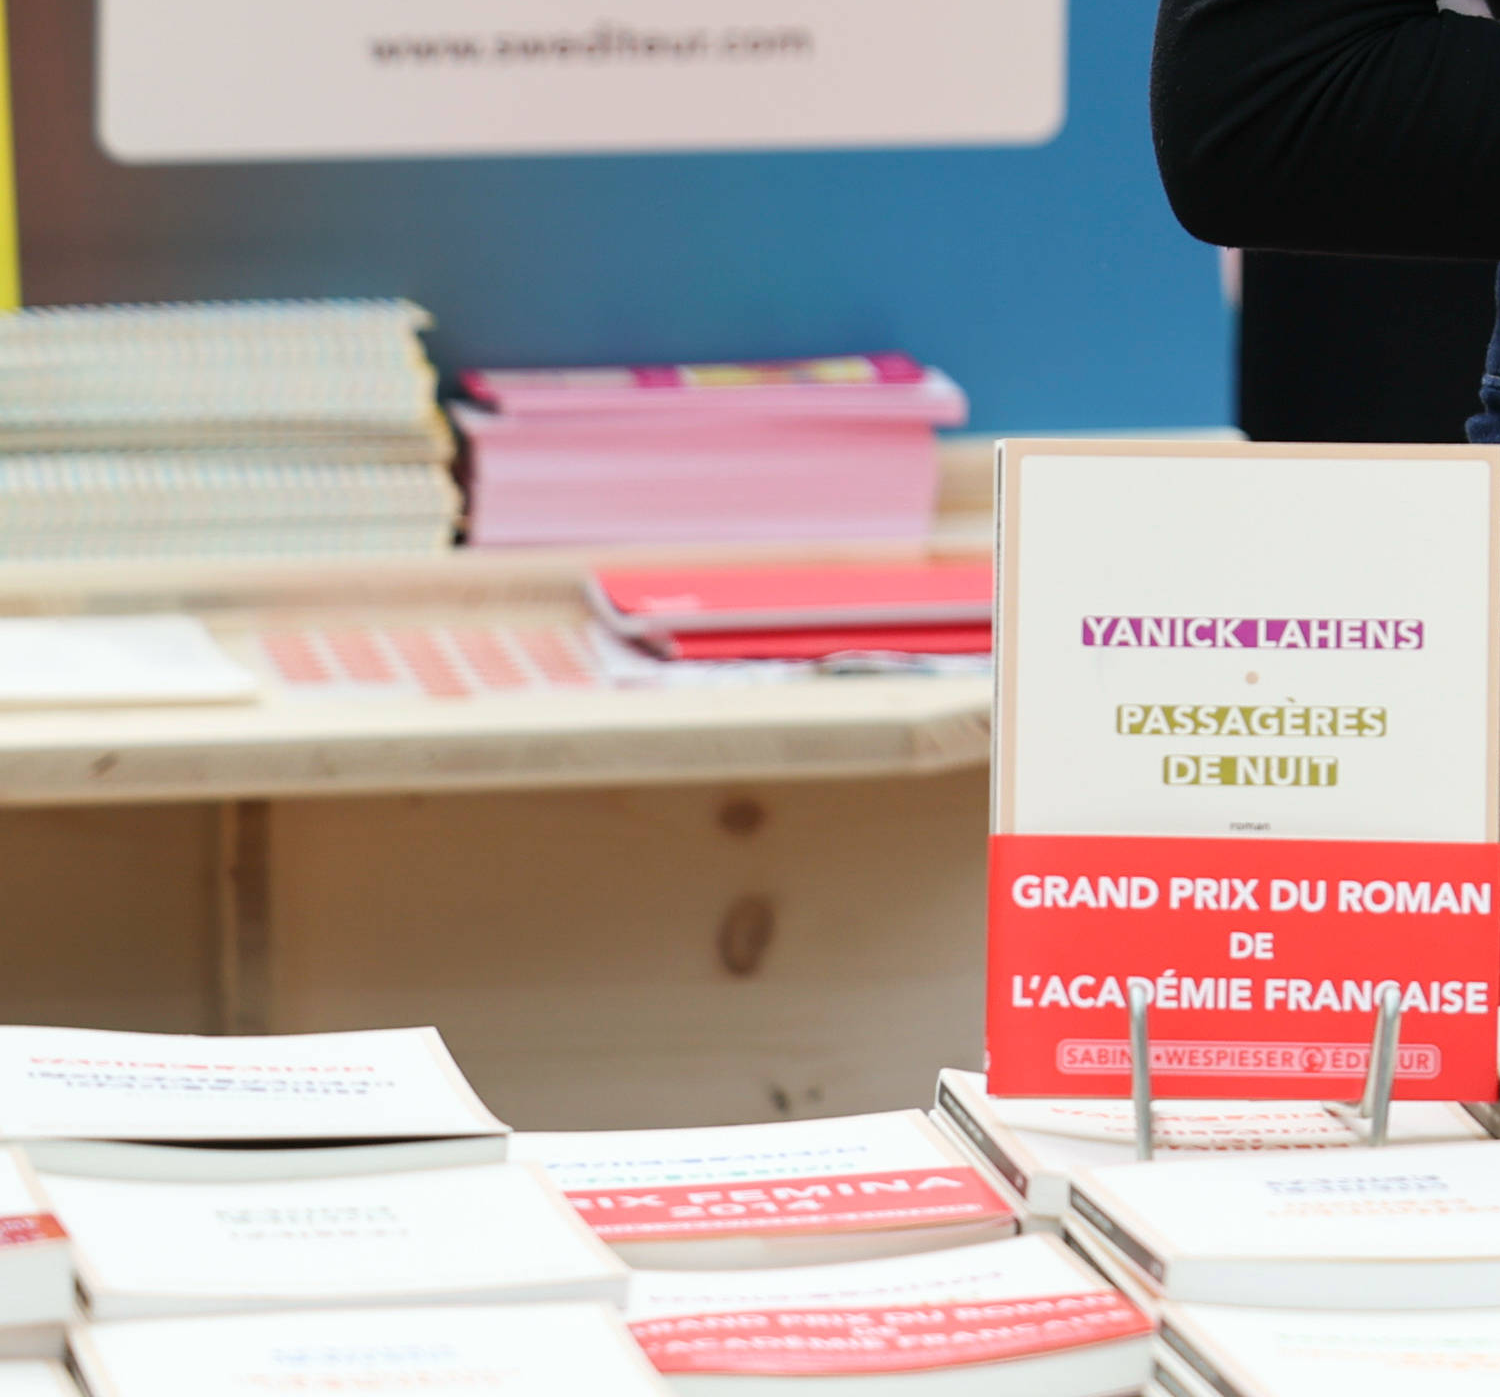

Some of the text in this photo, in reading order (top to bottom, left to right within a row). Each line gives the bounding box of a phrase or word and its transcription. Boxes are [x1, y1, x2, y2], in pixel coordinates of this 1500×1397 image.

[1084, 616, 1421, 649] YANICK LAHENS
[1118, 696, 1385, 737] PASSAGÈRES
[1166, 754, 1337, 787] DE NUIT
[1011, 875, 1492, 915] GRAND PRIX DU ROMAN
[1229, 932, 1275, 960] DE
[1066, 1047, 1133, 1067] SABIN
[1164, 1049, 1294, 1070] WESPIESER
[687, 1177, 965, 1205] FEMINA
